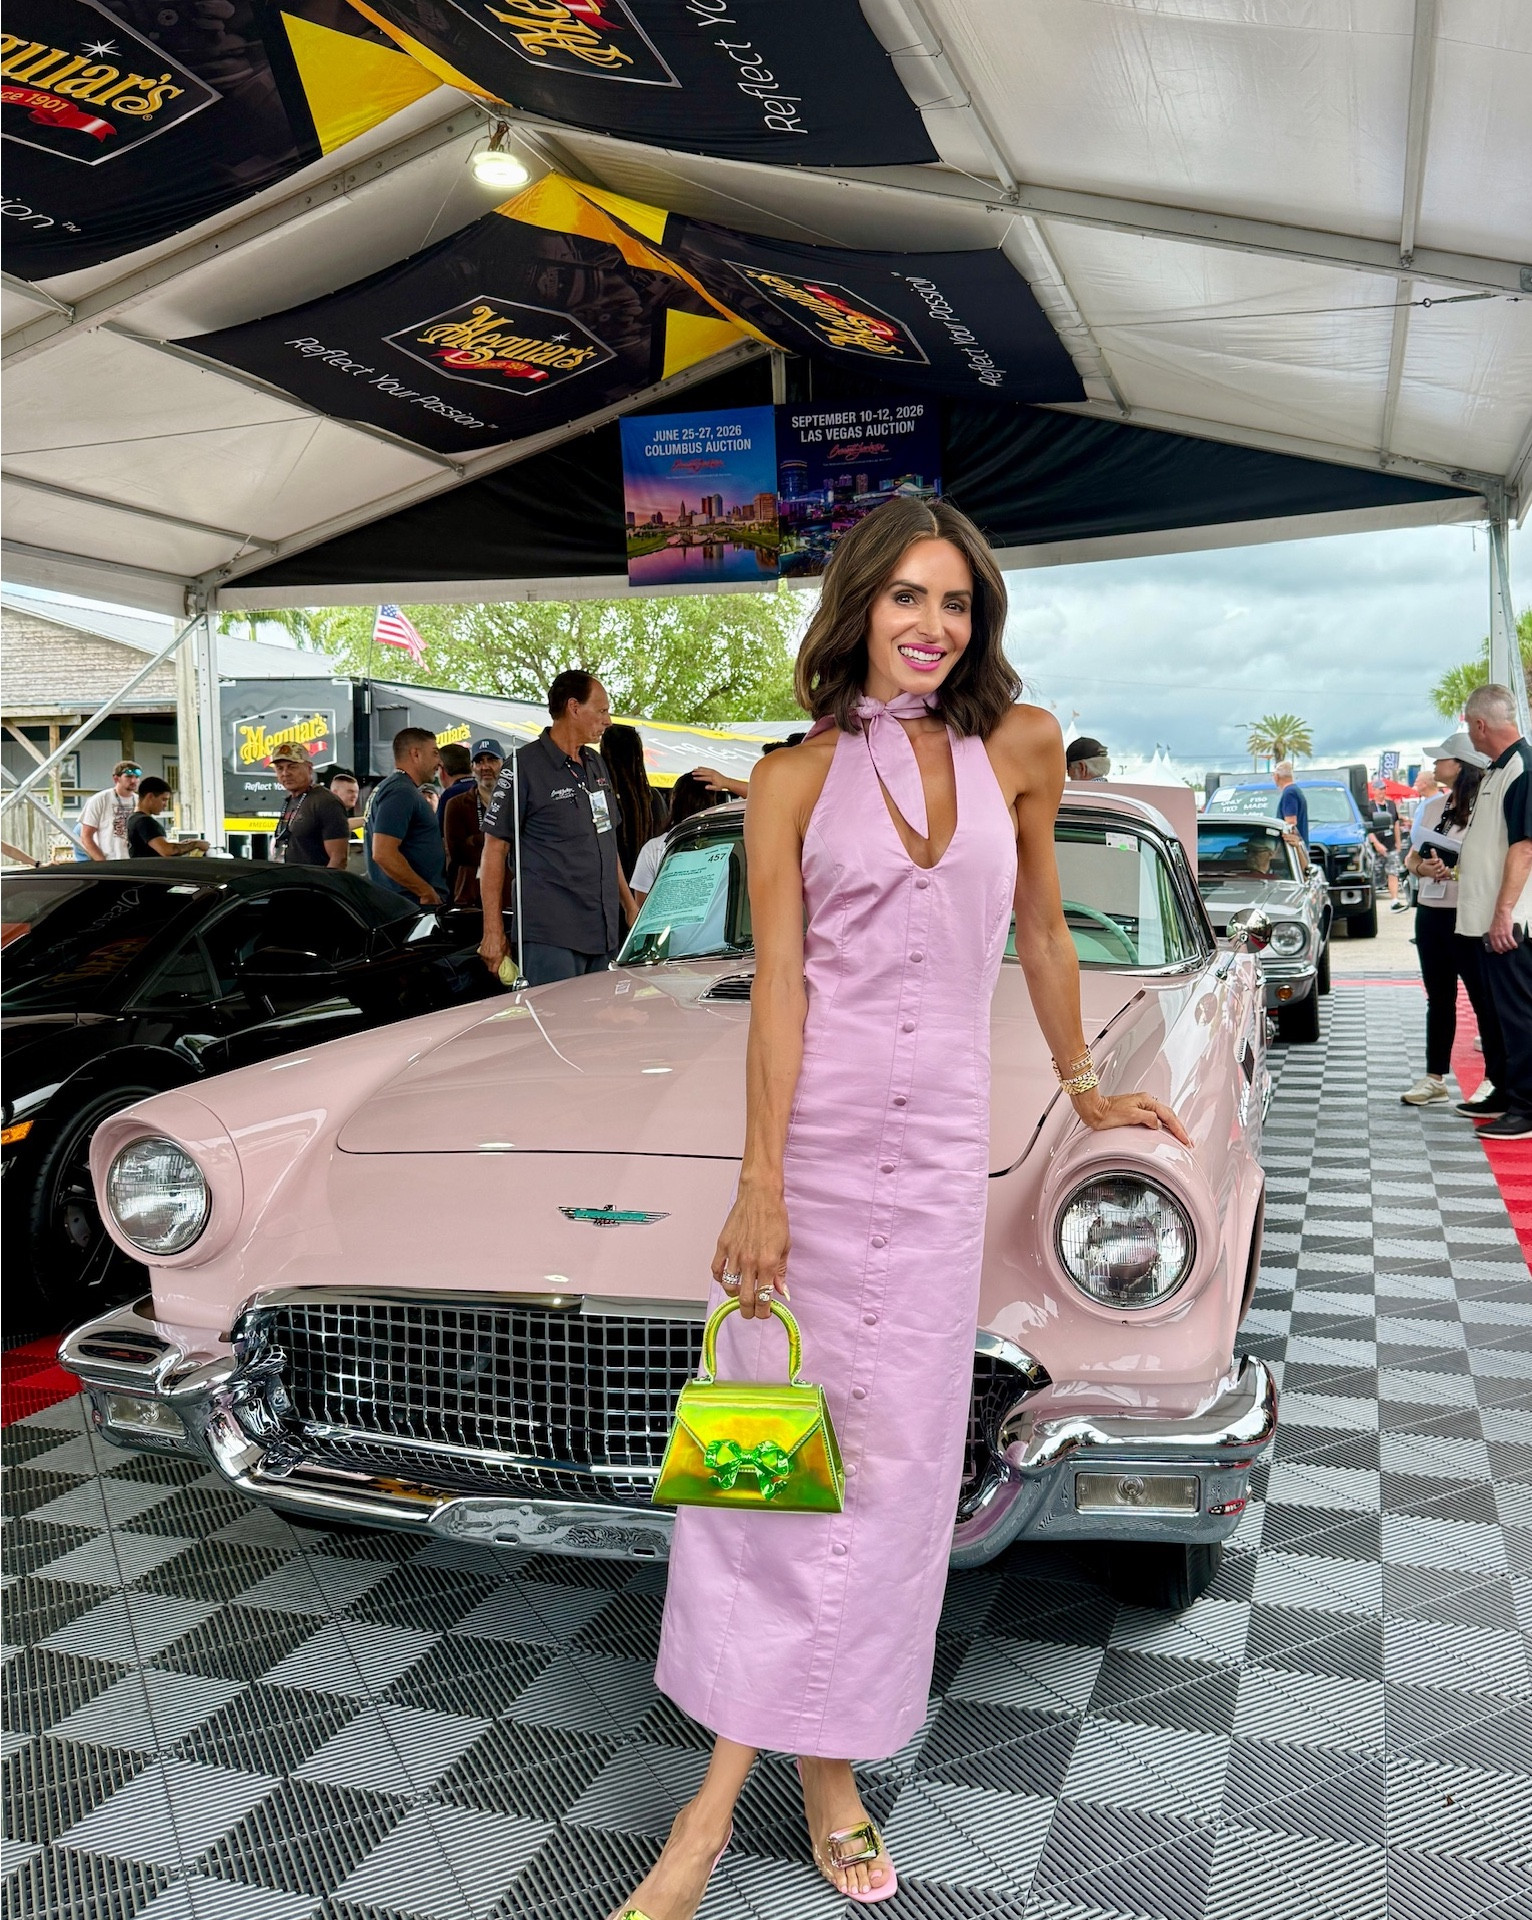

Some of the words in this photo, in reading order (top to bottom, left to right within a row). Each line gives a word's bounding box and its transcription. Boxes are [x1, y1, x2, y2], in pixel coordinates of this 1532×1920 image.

[714, 39, 808, 134] Reflect
[25, 93, 70, 113] 1901
[905, 276, 960, 321] Passion
[416, 305, 598, 369] Meguiar's
[943, 321, 979, 345] Your
[961, 348, 1007, 388] Reflect
[284, 337, 375, 377] Reflect
[368, 373, 420, 399] Your
[410, 395, 485, 429] Passion
[791, 411, 857, 428] SEPTEMBER
[859, 408, 894, 422] 10-12,
[895, 404, 924, 419] 2026
[652, 429, 680, 442] JUNE
[681, 427, 714, 440] 25-27,
[716, 424, 742, 438] 2026
[800, 429, 822, 443] LAS
[825, 425, 863, 441] VEGAS
[865, 419, 916, 437] AUCTION
[644, 442, 703, 457] COLUMBUS
[705, 438, 752, 453] AUCTION
[244, 781, 272, 792] Reflect
[1243, 802, 1269, 811] MADE
[707, 852, 727, 864] 457
